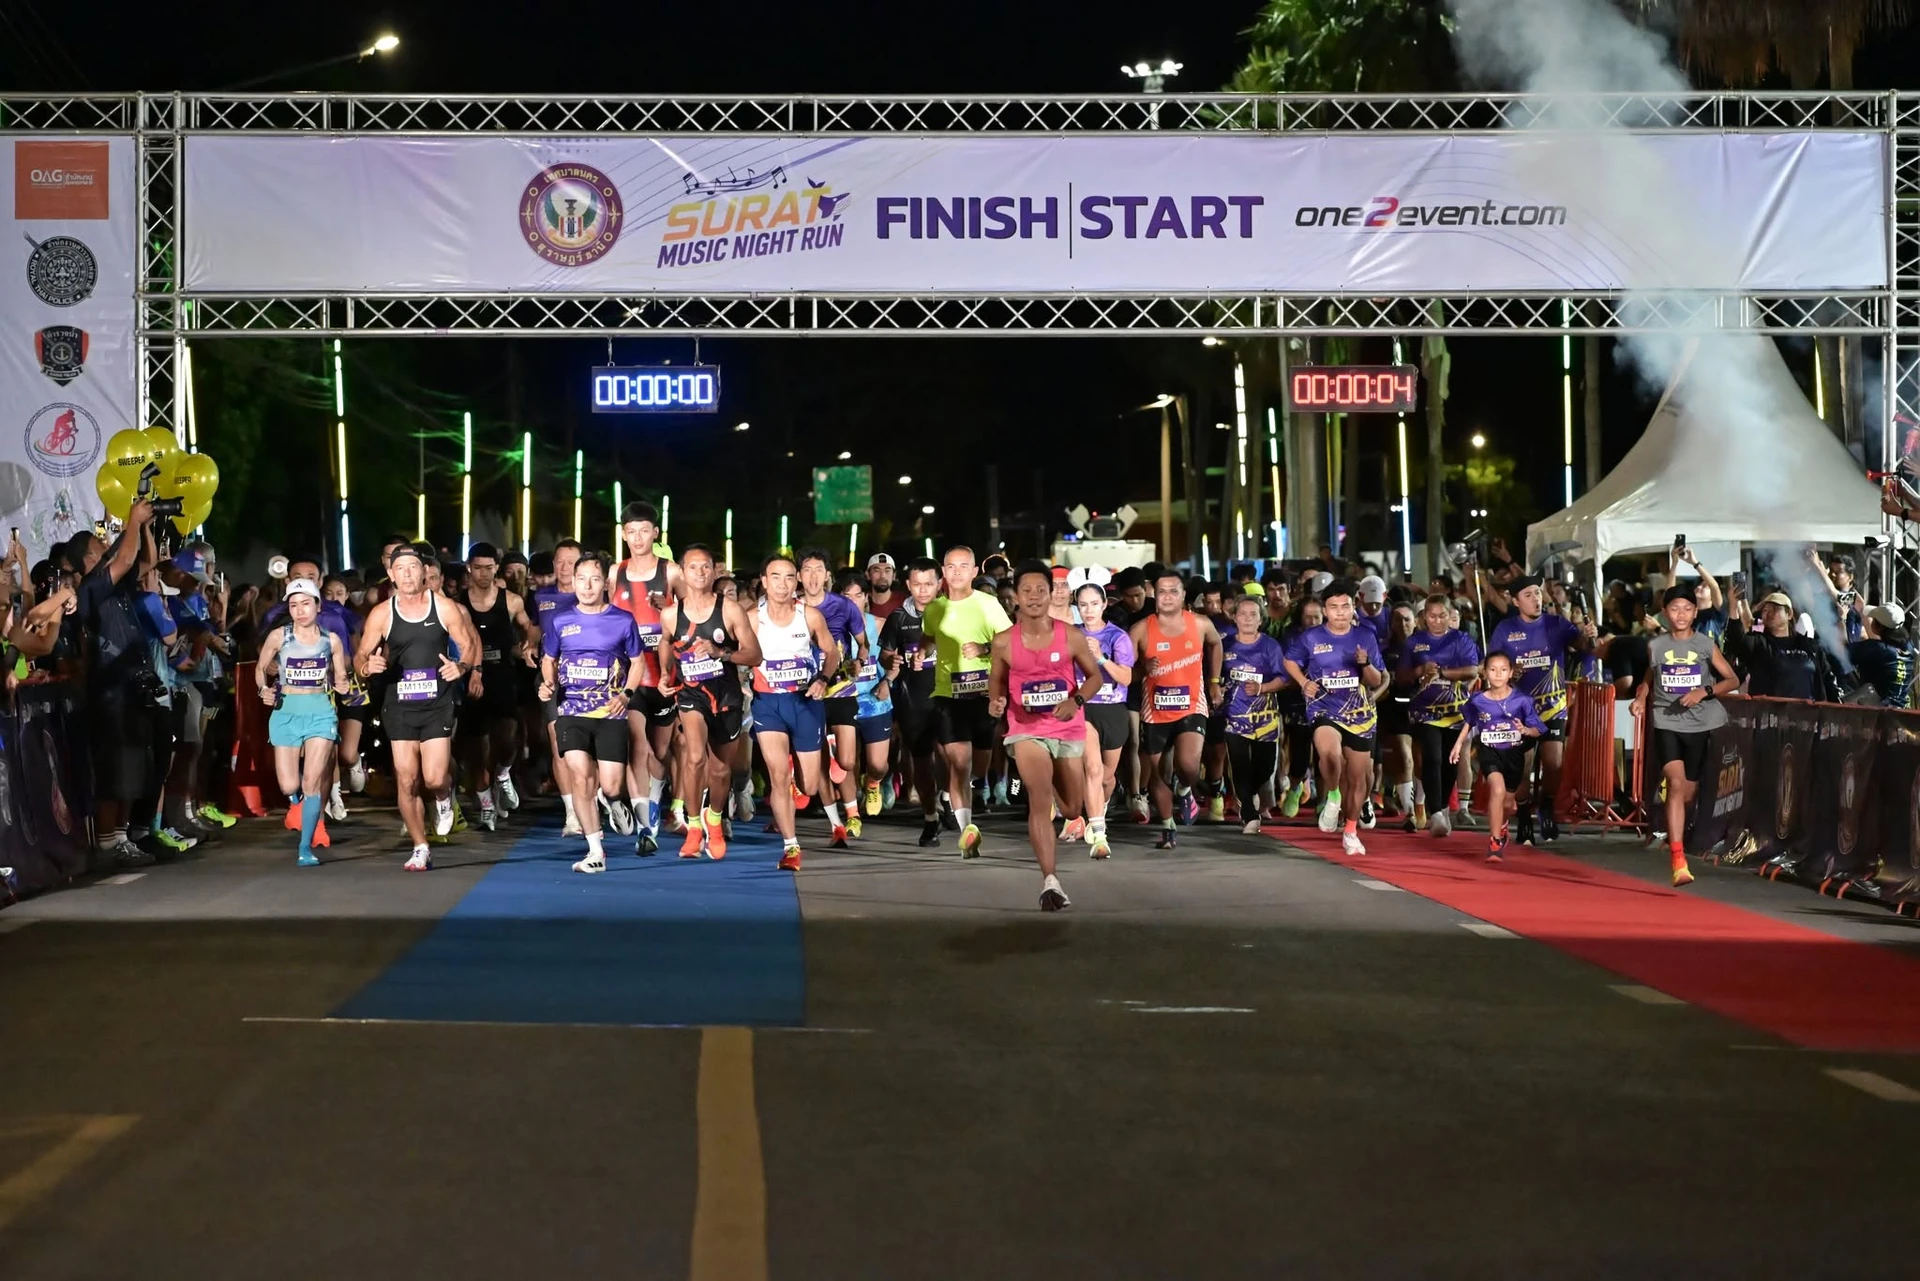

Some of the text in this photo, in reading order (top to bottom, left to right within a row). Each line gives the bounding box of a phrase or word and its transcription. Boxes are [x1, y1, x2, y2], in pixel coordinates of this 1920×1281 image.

[543, 168, 599, 183] เทศบาลนคร
[662, 186, 831, 242] SURAT
[877, 195, 1264, 239] FINISH START
[1295, 196, 1567, 228] one2event.com
[657, 223, 844, 268] MUSIC NIGHT RUN
[29, 259, 75, 305] ROYAL THAI POLICE
[595, 374, 713, 405] 00:00:00
[1294, 374, 1411, 404] 00:00:04
[117, 455, 146, 466] SWEEPER
[688, 660, 718, 673] M1206
[1522, 657, 1547, 666] M1042
[293, 669, 322, 678] M1157
[574, 668, 603, 677] M1202
[774, 669, 803, 679] M1170
[1668, 676, 1696, 684] M1501
[404, 681, 433, 691] M1159
[960, 681, 986, 691] M1238
[1031, 692, 1063, 703] M1203
[1488, 731, 1517, 740] M1251
